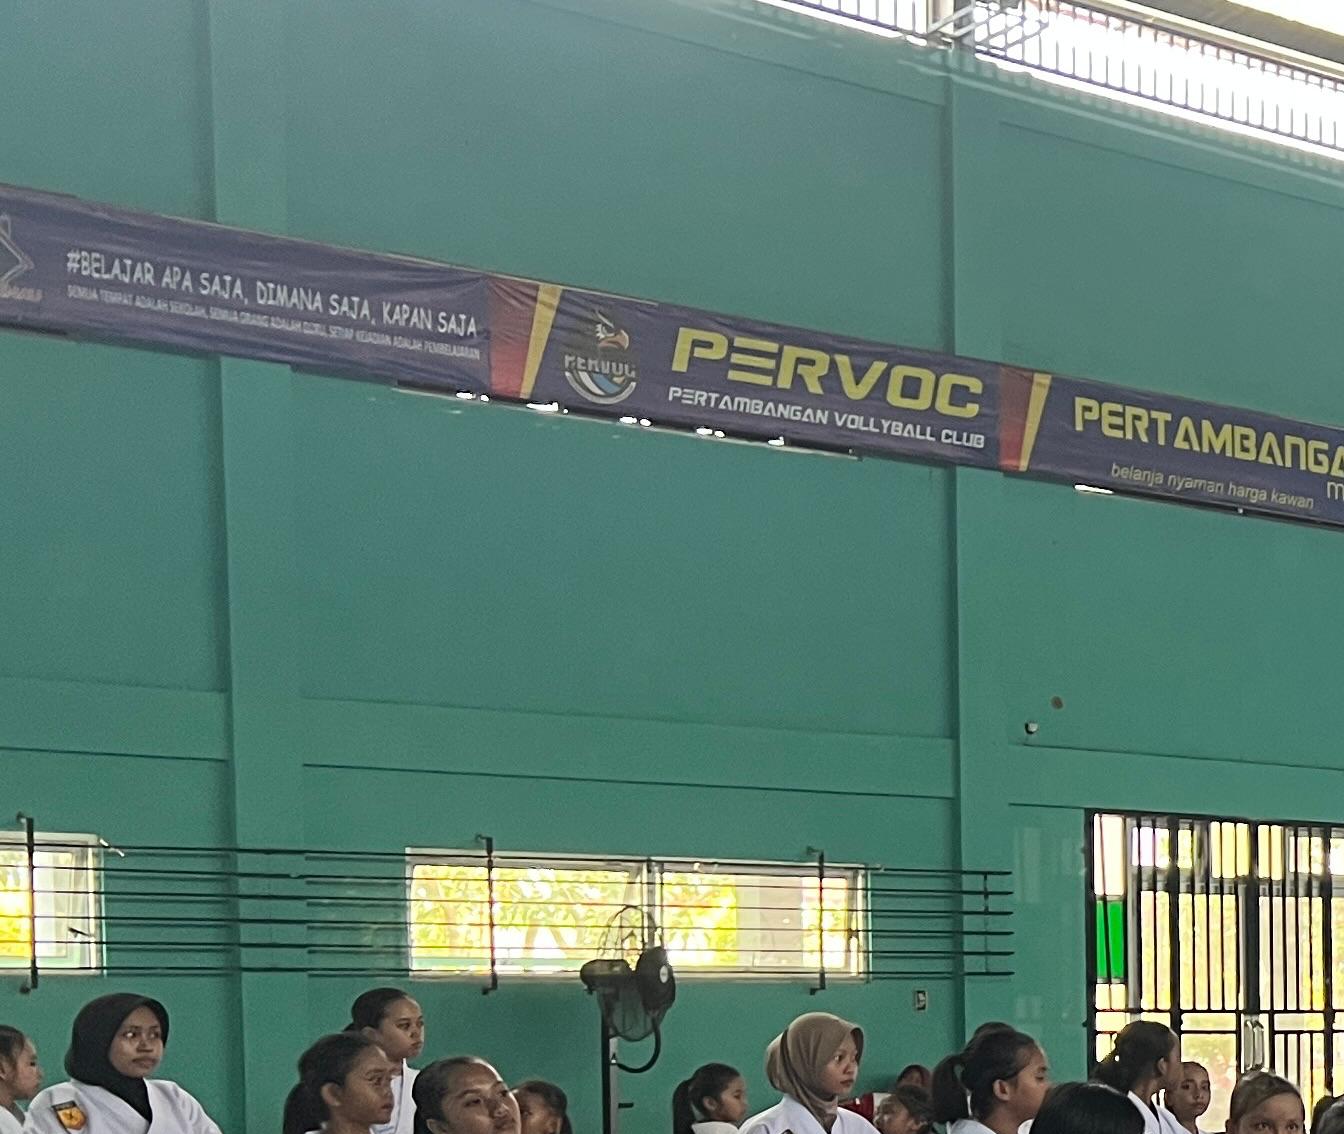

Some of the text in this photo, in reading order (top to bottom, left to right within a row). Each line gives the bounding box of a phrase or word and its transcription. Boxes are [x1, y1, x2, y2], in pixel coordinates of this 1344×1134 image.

[67, 249, 156, 287] #BELAJAR
[161, 266, 193, 293] APA
[200, 272, 249, 305] SAJA,
[256, 280, 323, 313] DIMANA
[382, 301, 432, 331] KAPAN
[438, 311, 478, 337] SAJA
[671, 327, 983, 419] PERVOC
[668, 386, 985, 449] PERTAMBANGAN VOLLYBALL CLUB
[1111, 462, 1314, 510] belanja nyaman harga kawan
